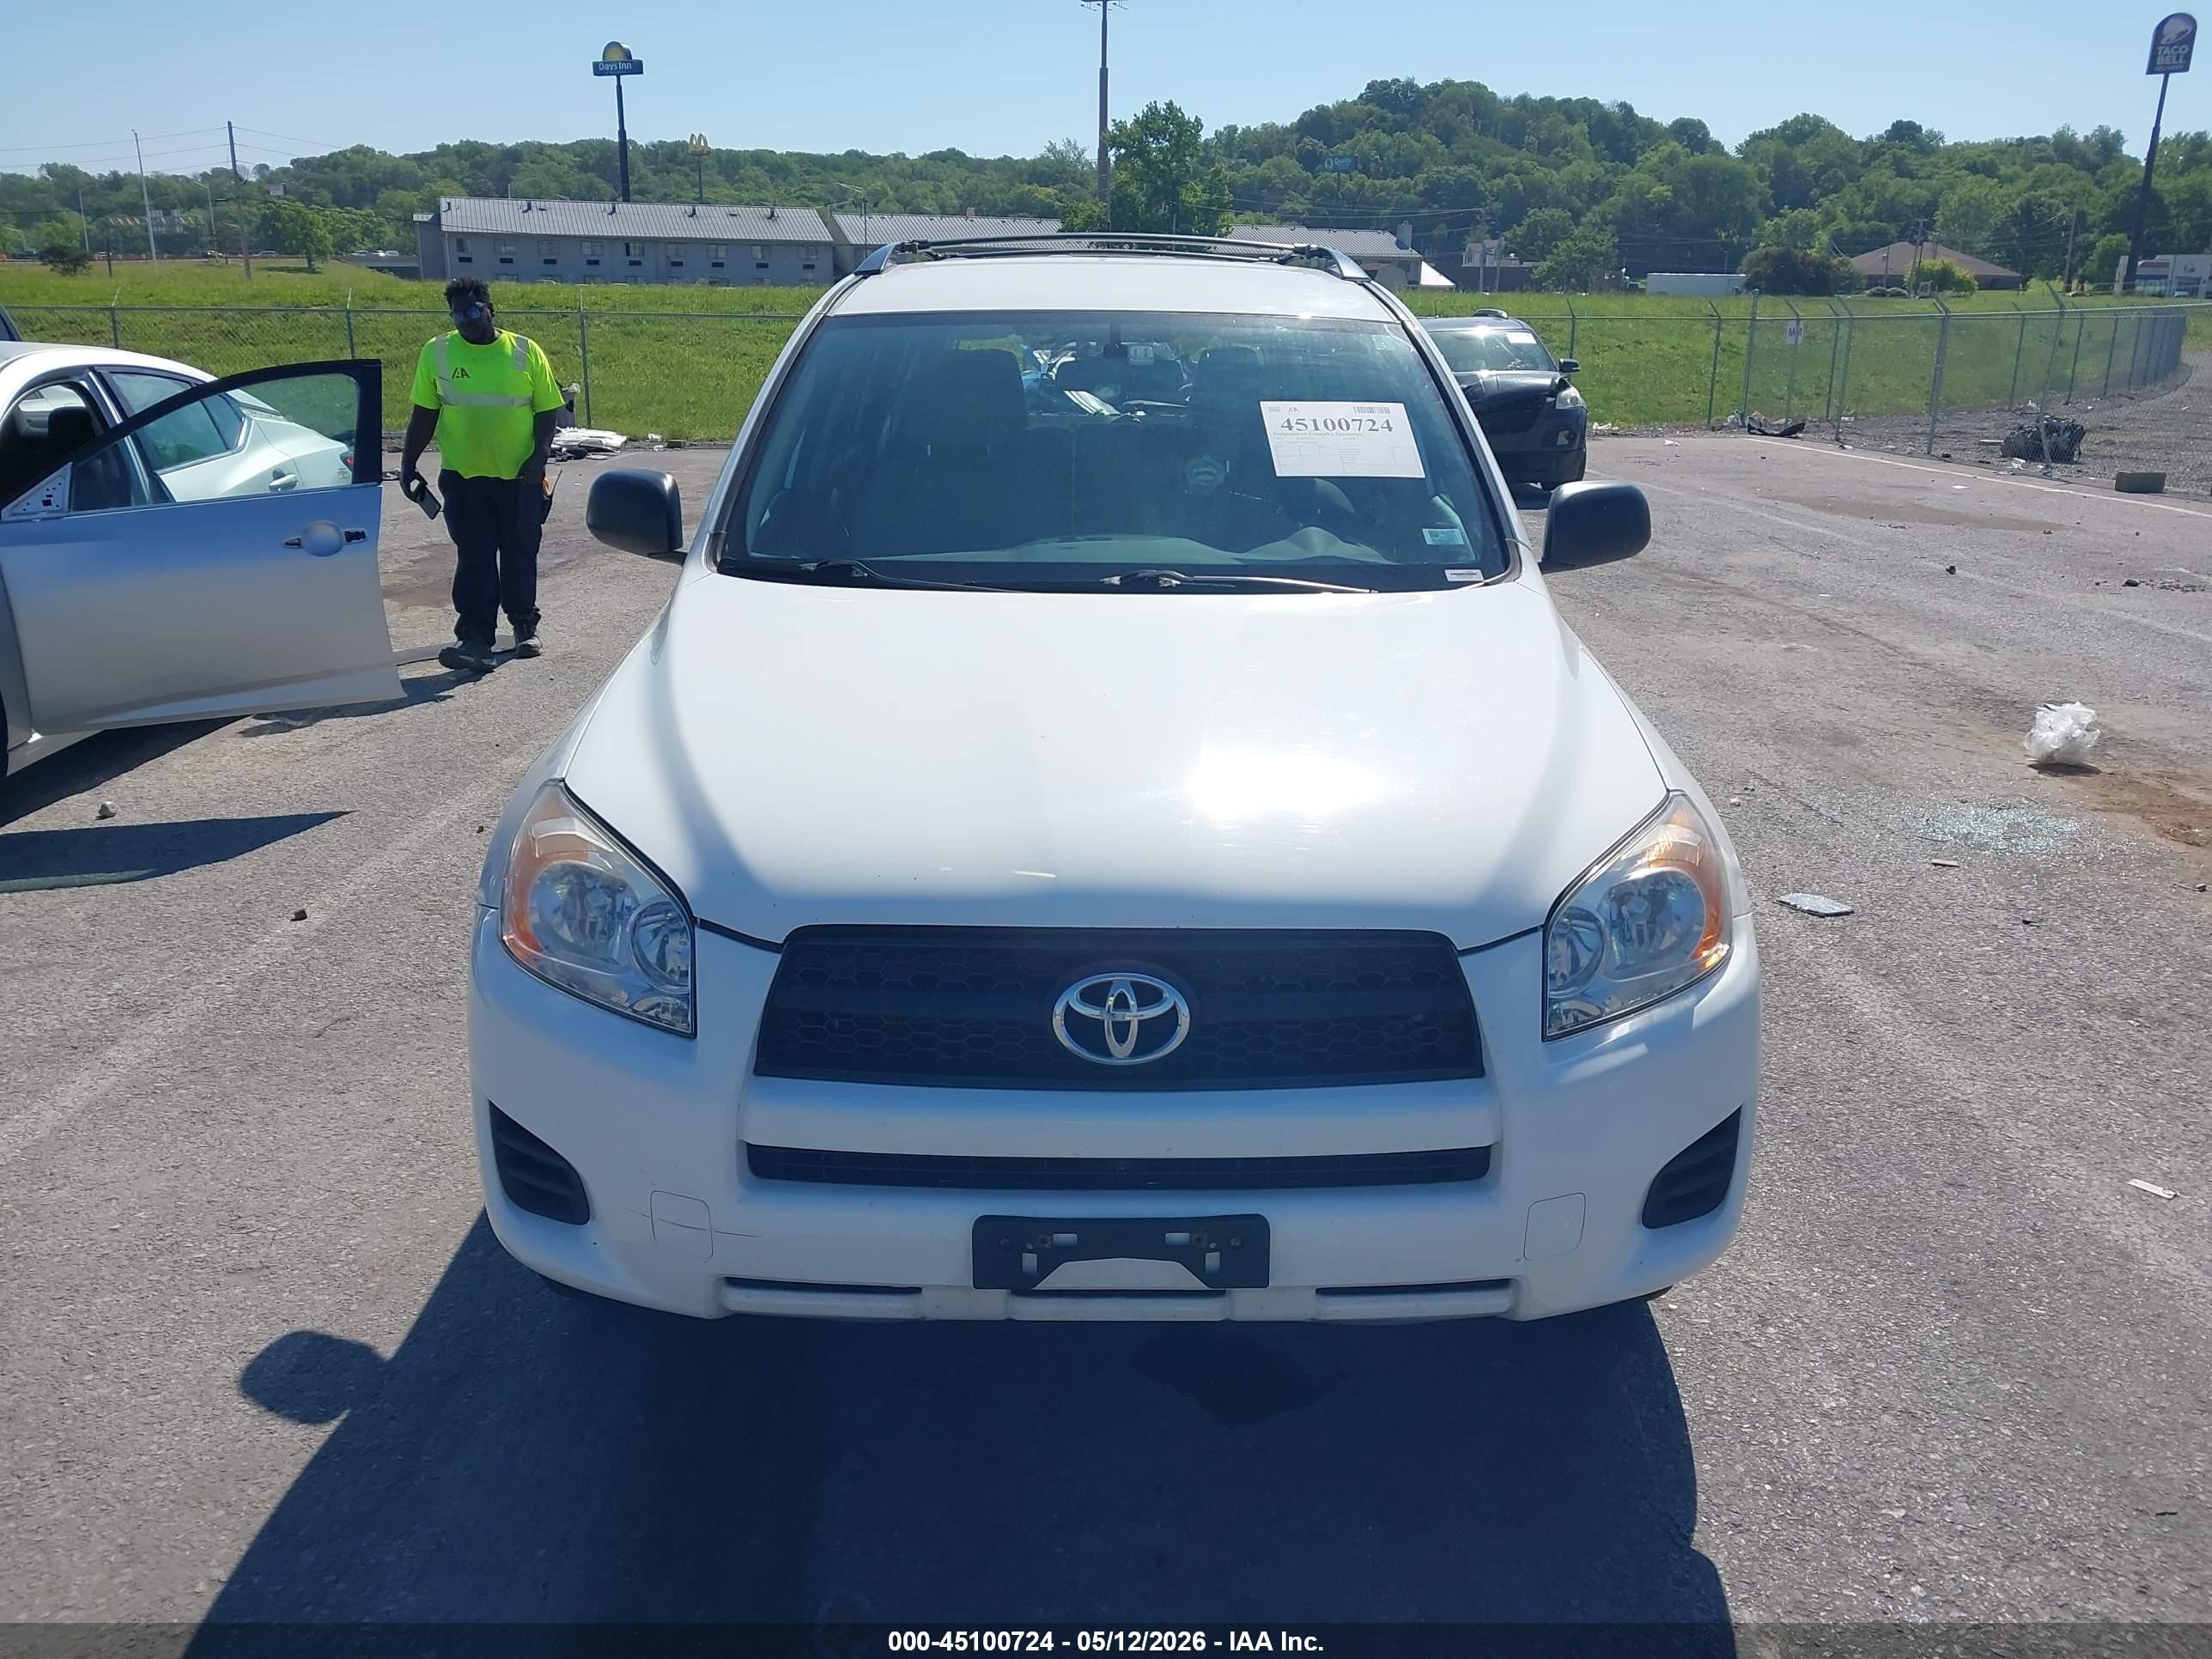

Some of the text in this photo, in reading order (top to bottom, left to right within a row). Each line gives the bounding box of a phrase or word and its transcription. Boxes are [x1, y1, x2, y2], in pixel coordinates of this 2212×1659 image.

[2156, 45, 2189, 56] TACO
[2156, 54, 2186, 65] BELL
[599, 61, 632, 71] Days Inn
[1280, 417, 1394, 432] 45100724
